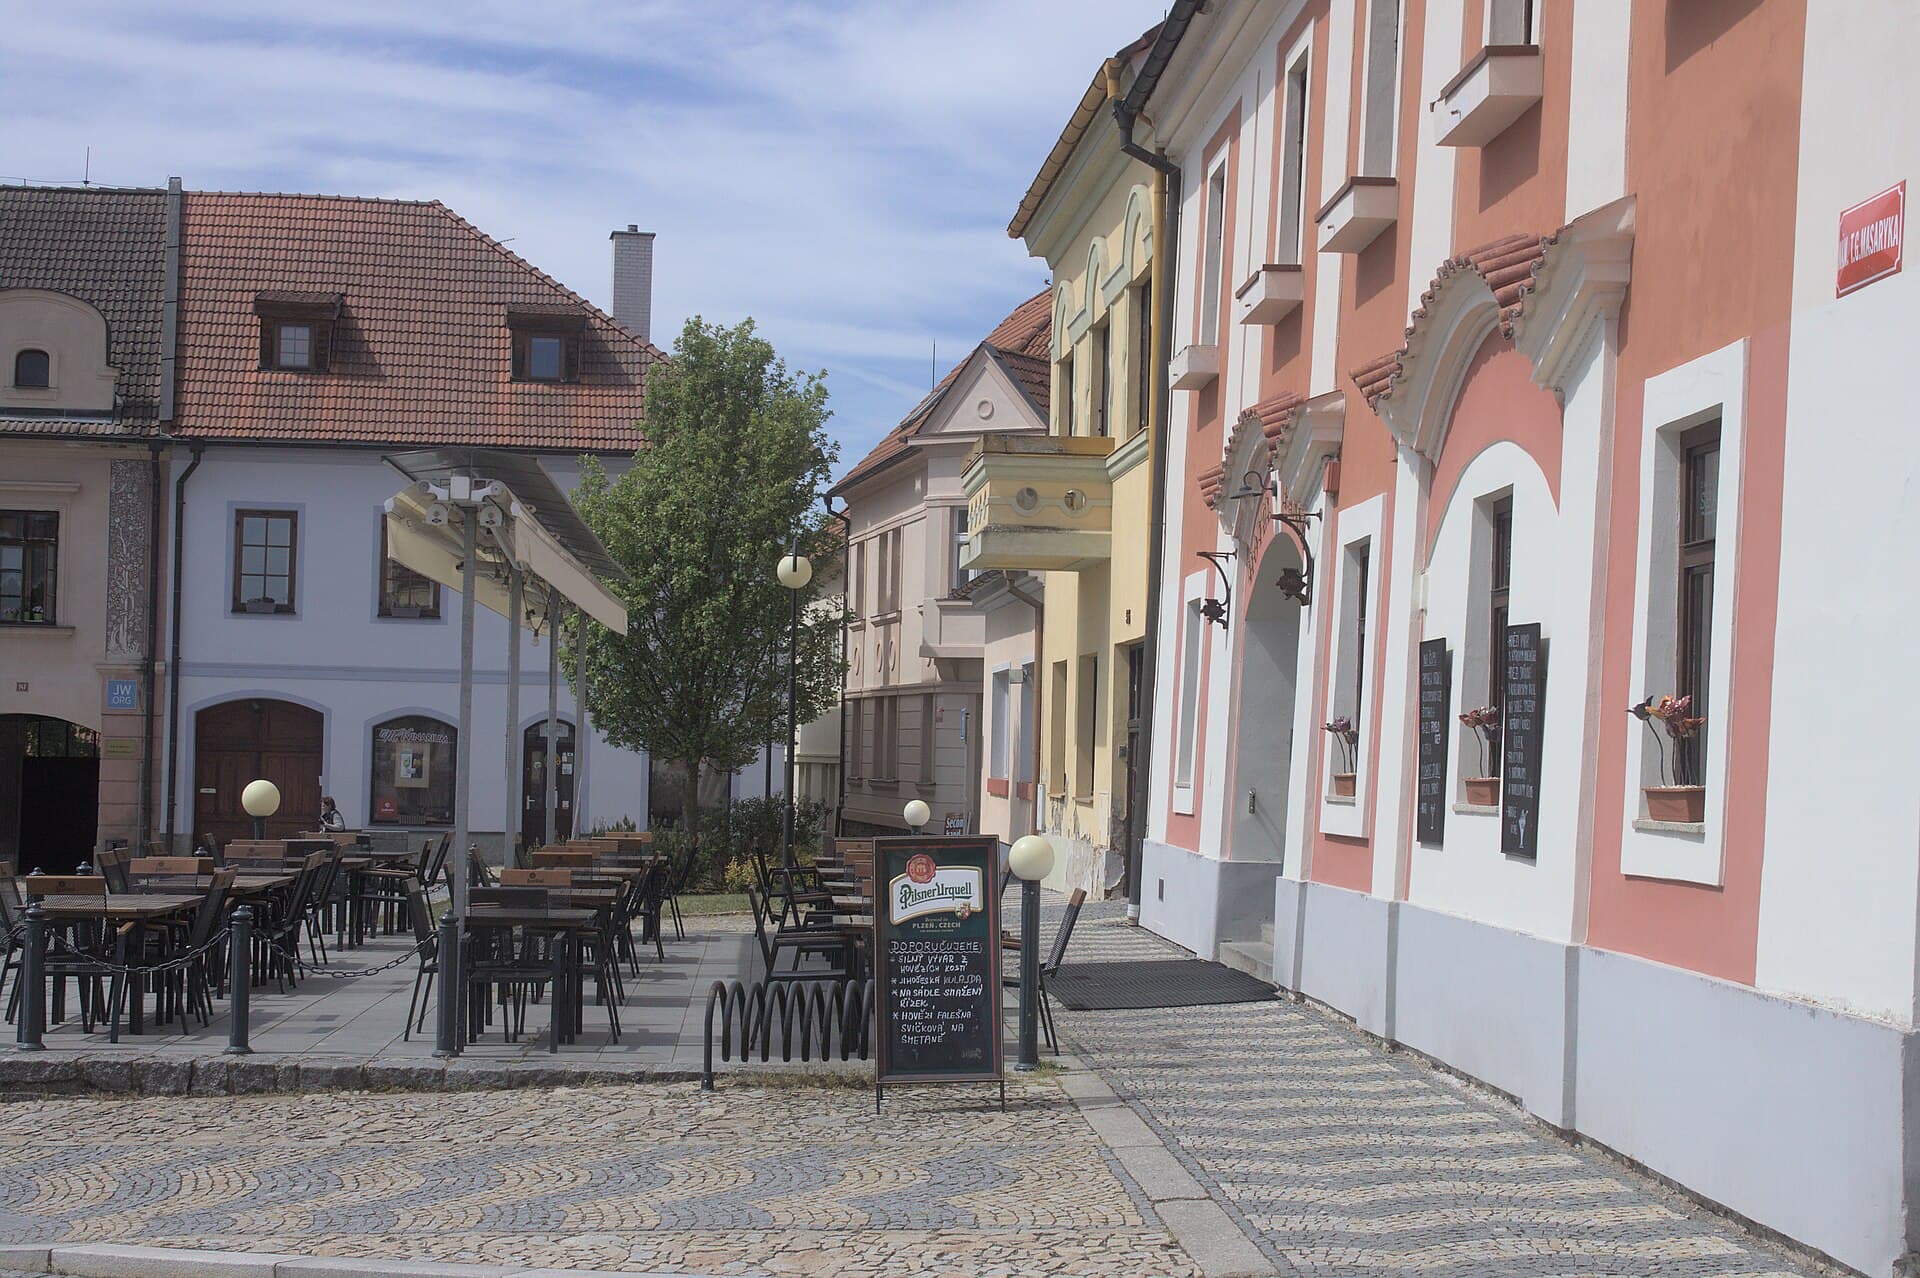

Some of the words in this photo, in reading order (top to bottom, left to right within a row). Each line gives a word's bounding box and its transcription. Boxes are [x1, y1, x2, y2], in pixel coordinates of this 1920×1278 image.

[112, 684, 132, 696] JW
[112, 696, 132, 705] ORG
[899, 884, 937, 910] Pilsner
[936, 882, 973, 900] Urquell
[890, 940, 980, 952] DOPORUČUJEME
[899, 988, 911, 998] NA
[912, 985, 941, 997] SÁDLE
[951, 1023, 964, 1033] NA
